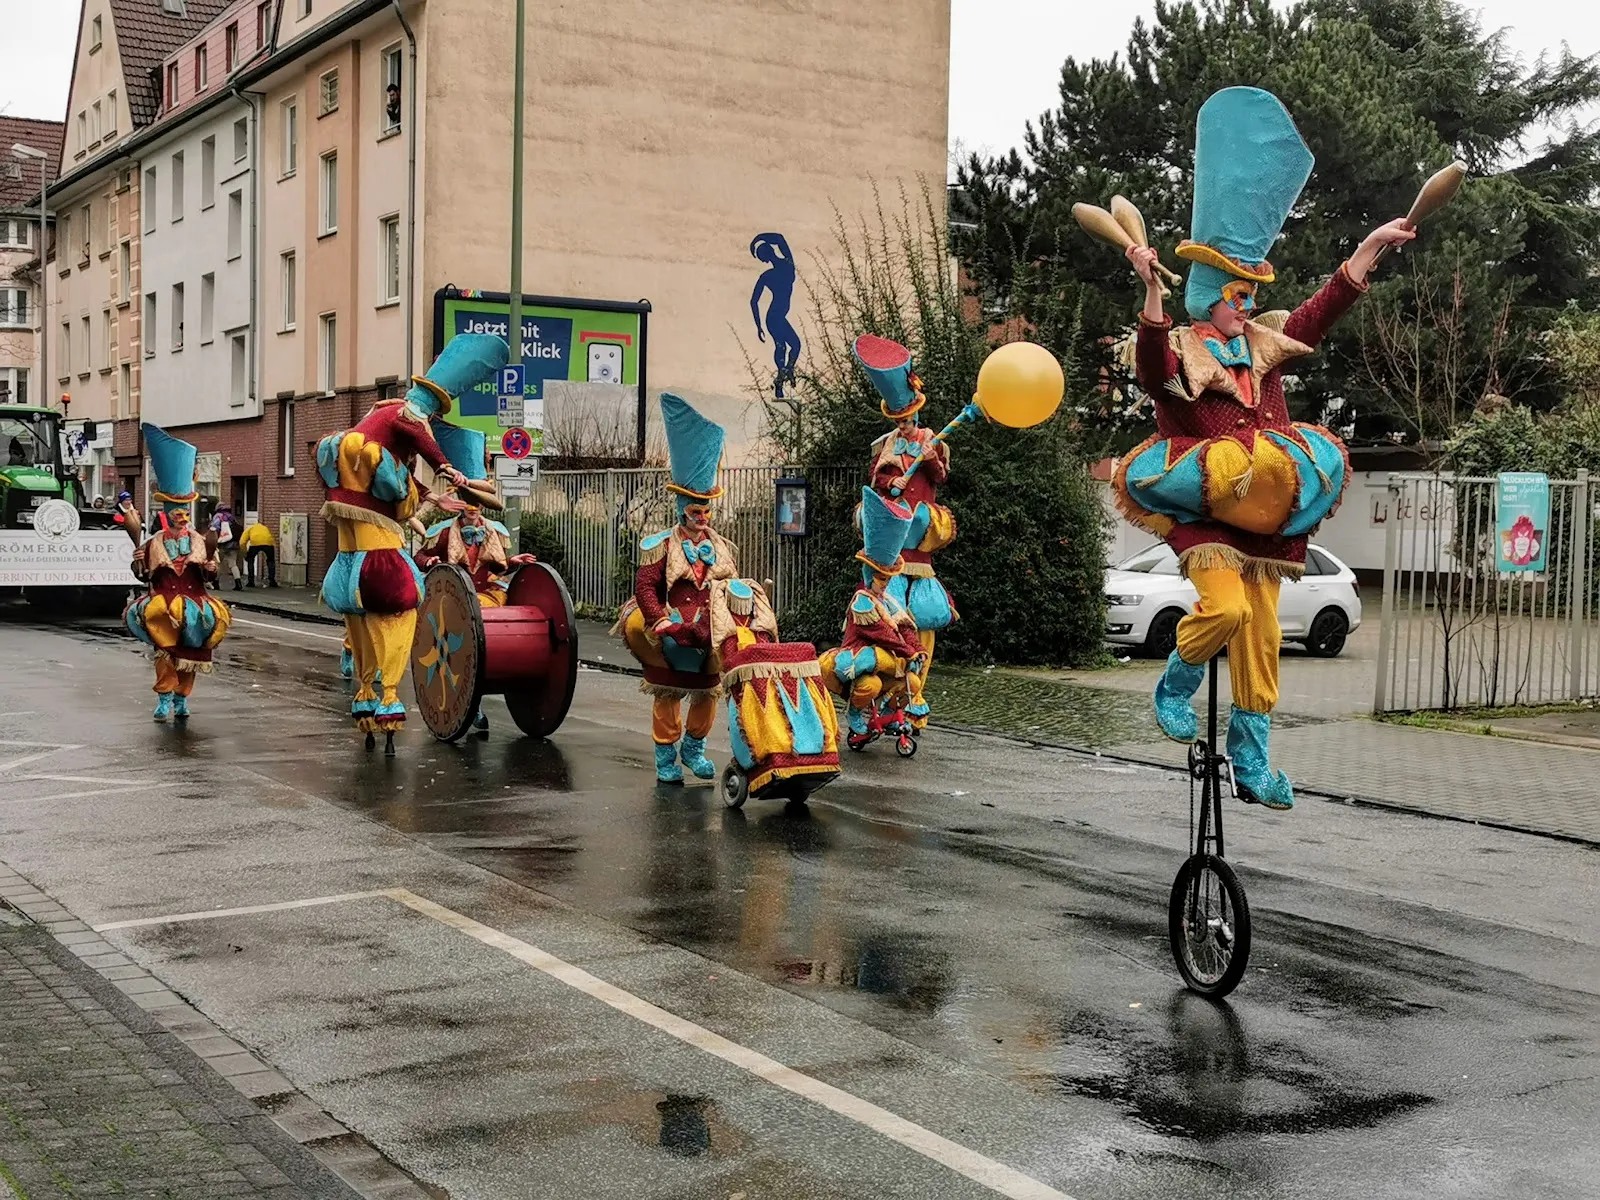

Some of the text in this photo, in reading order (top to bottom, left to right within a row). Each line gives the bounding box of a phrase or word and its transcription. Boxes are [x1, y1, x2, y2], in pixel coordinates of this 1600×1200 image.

[464, 319, 508, 336] Jetzt
[521, 342, 561, 359] Klick
[503, 368, 519, 394] P
[0, 542, 115, 554] RÖMERGARDE
[45, 572, 69, 582] UND
[73, 572, 97, 582] JECK
